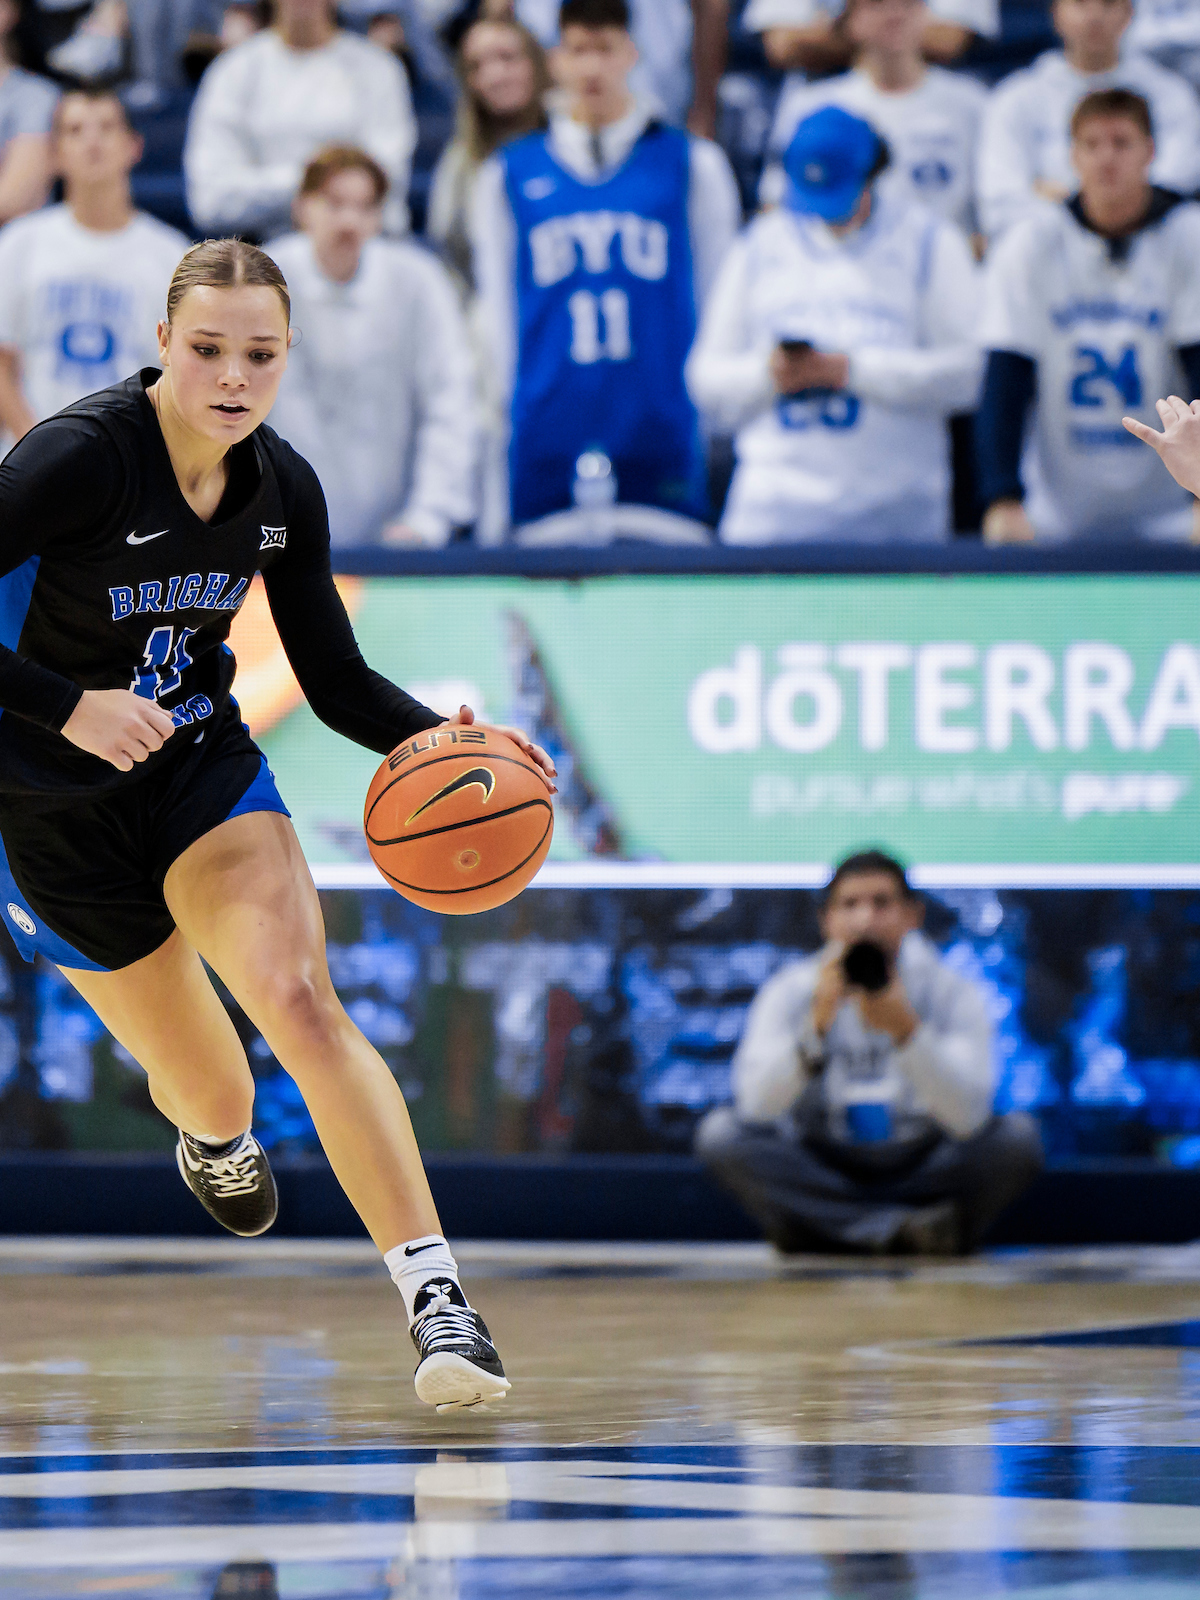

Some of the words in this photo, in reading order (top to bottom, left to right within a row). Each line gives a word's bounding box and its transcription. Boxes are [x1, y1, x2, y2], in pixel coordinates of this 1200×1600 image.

[529, 210, 669, 288] BYU
[568, 287, 632, 364] 11
[1068, 343, 1145, 408] 24
[688, 642, 1200, 754] dōTERRA
[388, 729, 488, 771] ELITE
